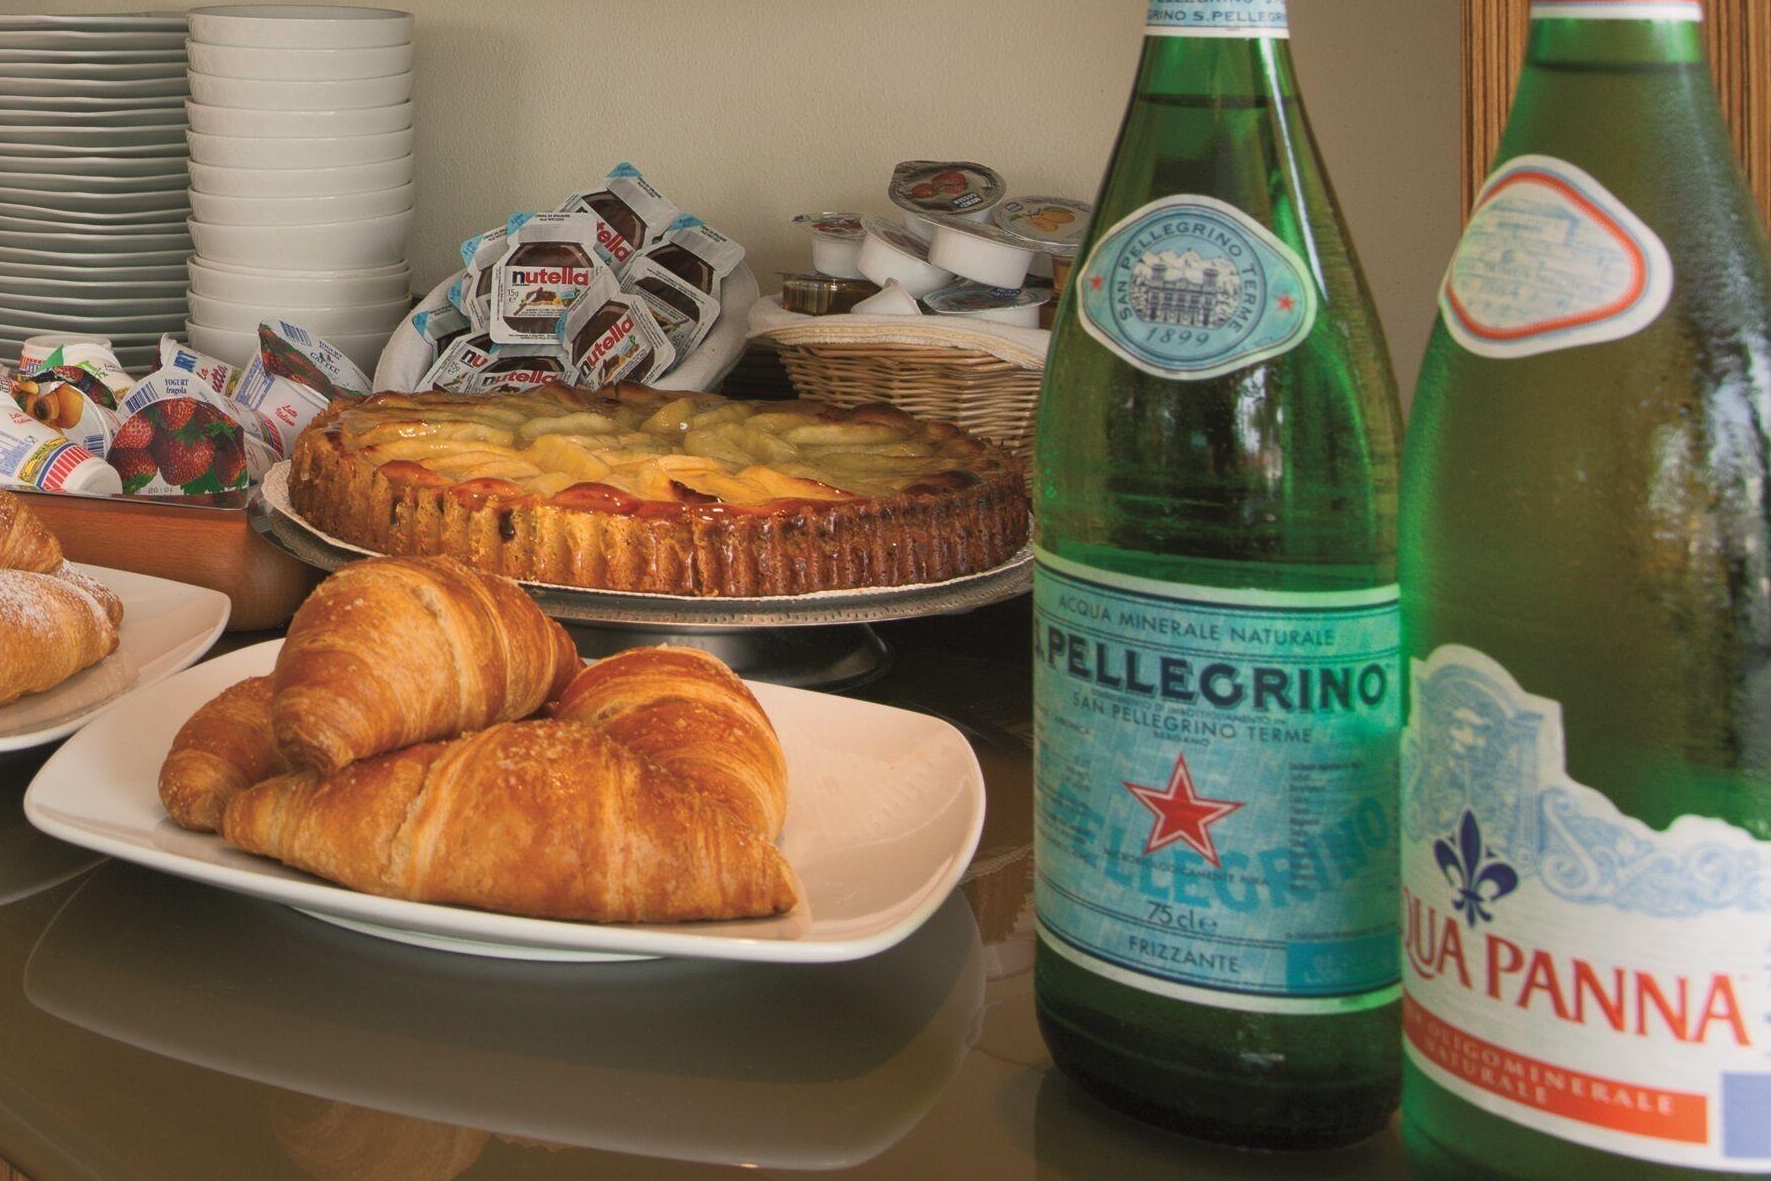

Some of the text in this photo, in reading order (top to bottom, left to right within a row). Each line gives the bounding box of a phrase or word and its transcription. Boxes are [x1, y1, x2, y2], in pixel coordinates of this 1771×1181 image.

[512, 266, 589, 286] nutella
[1117, 221, 1258, 334] SAN PELLEGRINO TERME
[579, 316, 634, 376] nutella
[1145, 326, 1210, 347] 1899
[166, 386, 187, 396] fragola
[1058, 595, 1335, 647] ACQUA MINERALE NATURALE
[1073, 692, 1105, 716] SAN
[1112, 703, 1237, 740] PELLEGRINO
[1248, 725, 1312, 745] TERME
[1128, 934, 1240, 974] FRIZZANTE
[1485, 931, 1753, 1048] PANNA
[1428, 1024, 1675, 1117] OLIGOMINERALE
